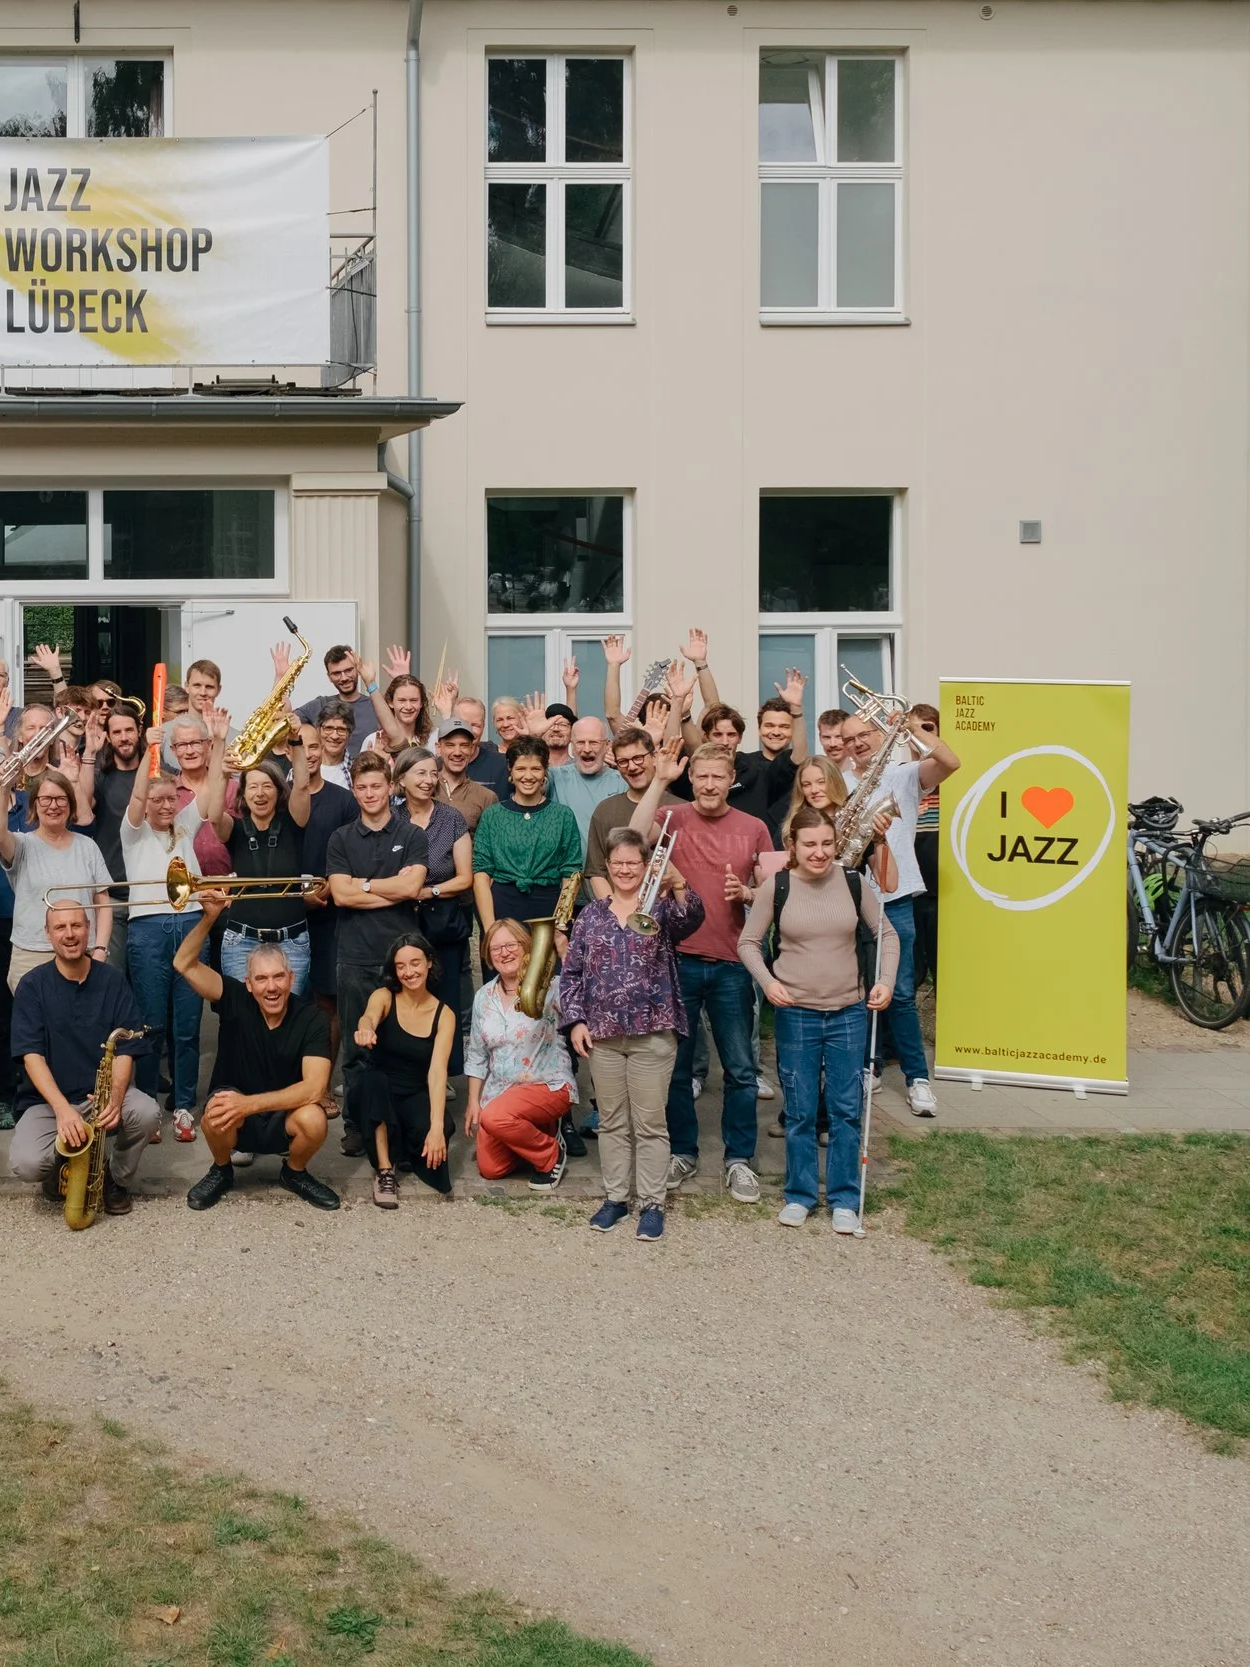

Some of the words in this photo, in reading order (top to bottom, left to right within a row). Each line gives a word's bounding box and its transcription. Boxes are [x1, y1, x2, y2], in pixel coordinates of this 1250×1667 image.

[4, 167, 91, 212] JAZZ
[5, 228, 213, 273] WORKSHOP
[6, 278, 149, 334] LÜBECK
[955, 695, 985, 706] BALTIC
[955, 708, 975, 719] JAZZ
[955, 721, 996, 732] ACADEMY
[1000, 791, 1007, 819] I
[987, 834, 1079, 866] JAZZ
[954, 1045, 1107, 1064] www.balticjazzacademy.de
